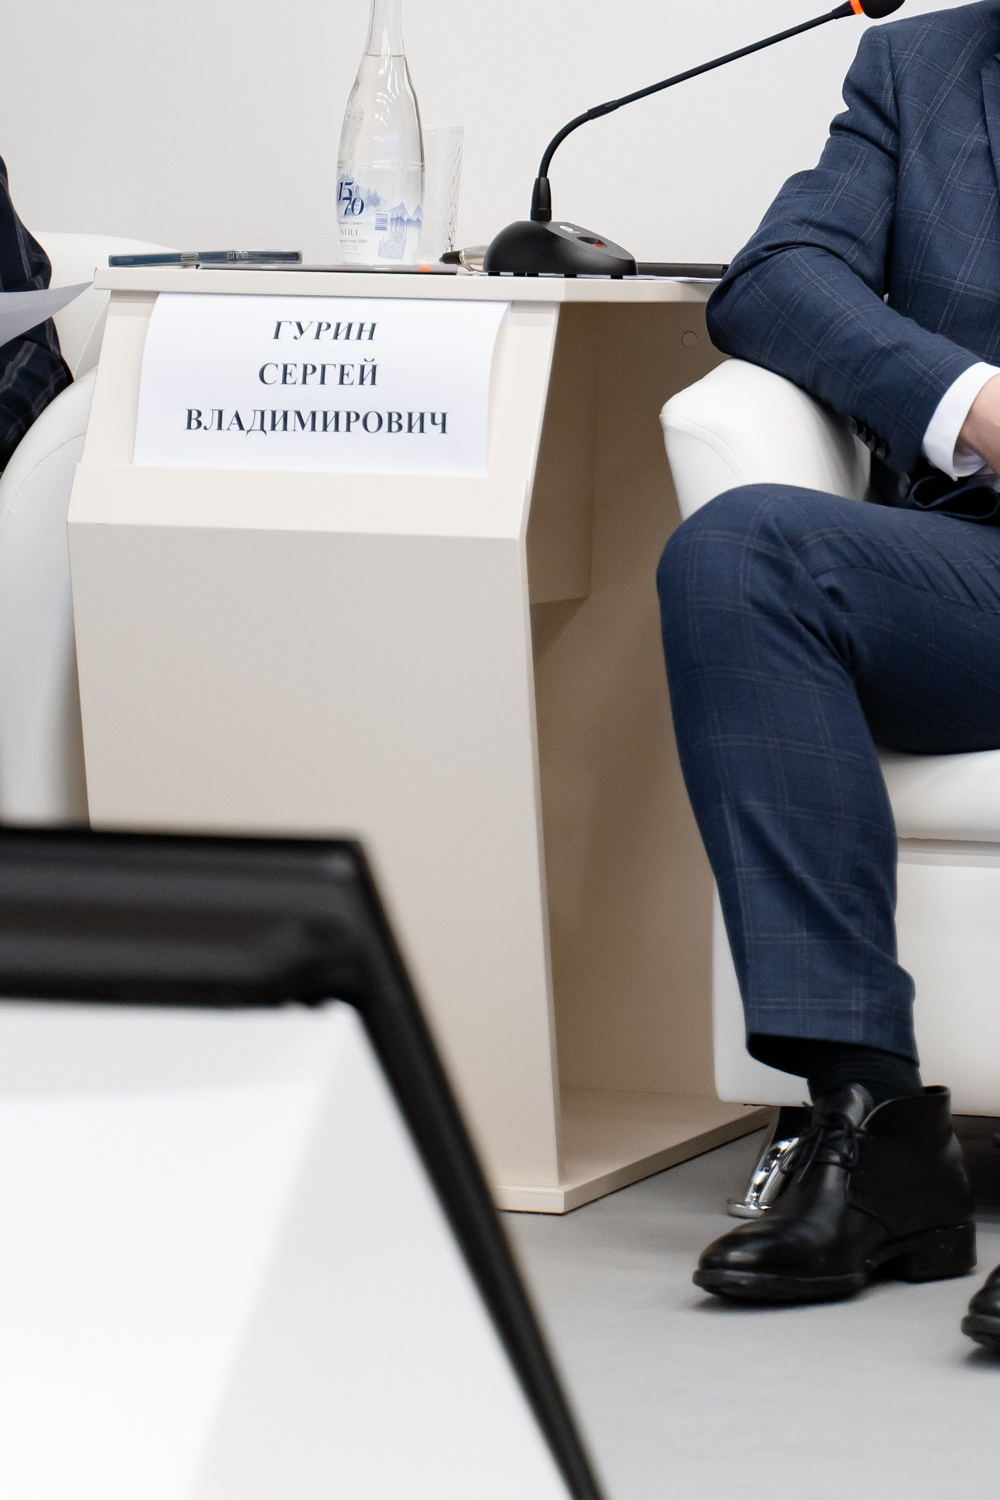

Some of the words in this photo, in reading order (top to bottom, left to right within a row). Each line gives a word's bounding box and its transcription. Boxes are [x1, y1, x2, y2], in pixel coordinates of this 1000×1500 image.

[272, 320, 379, 342] ГУРИН
[258, 357, 380, 387] СЕРГЕЙ
[184, 407, 450, 438] ВЛАДИМИРОВИЧ
